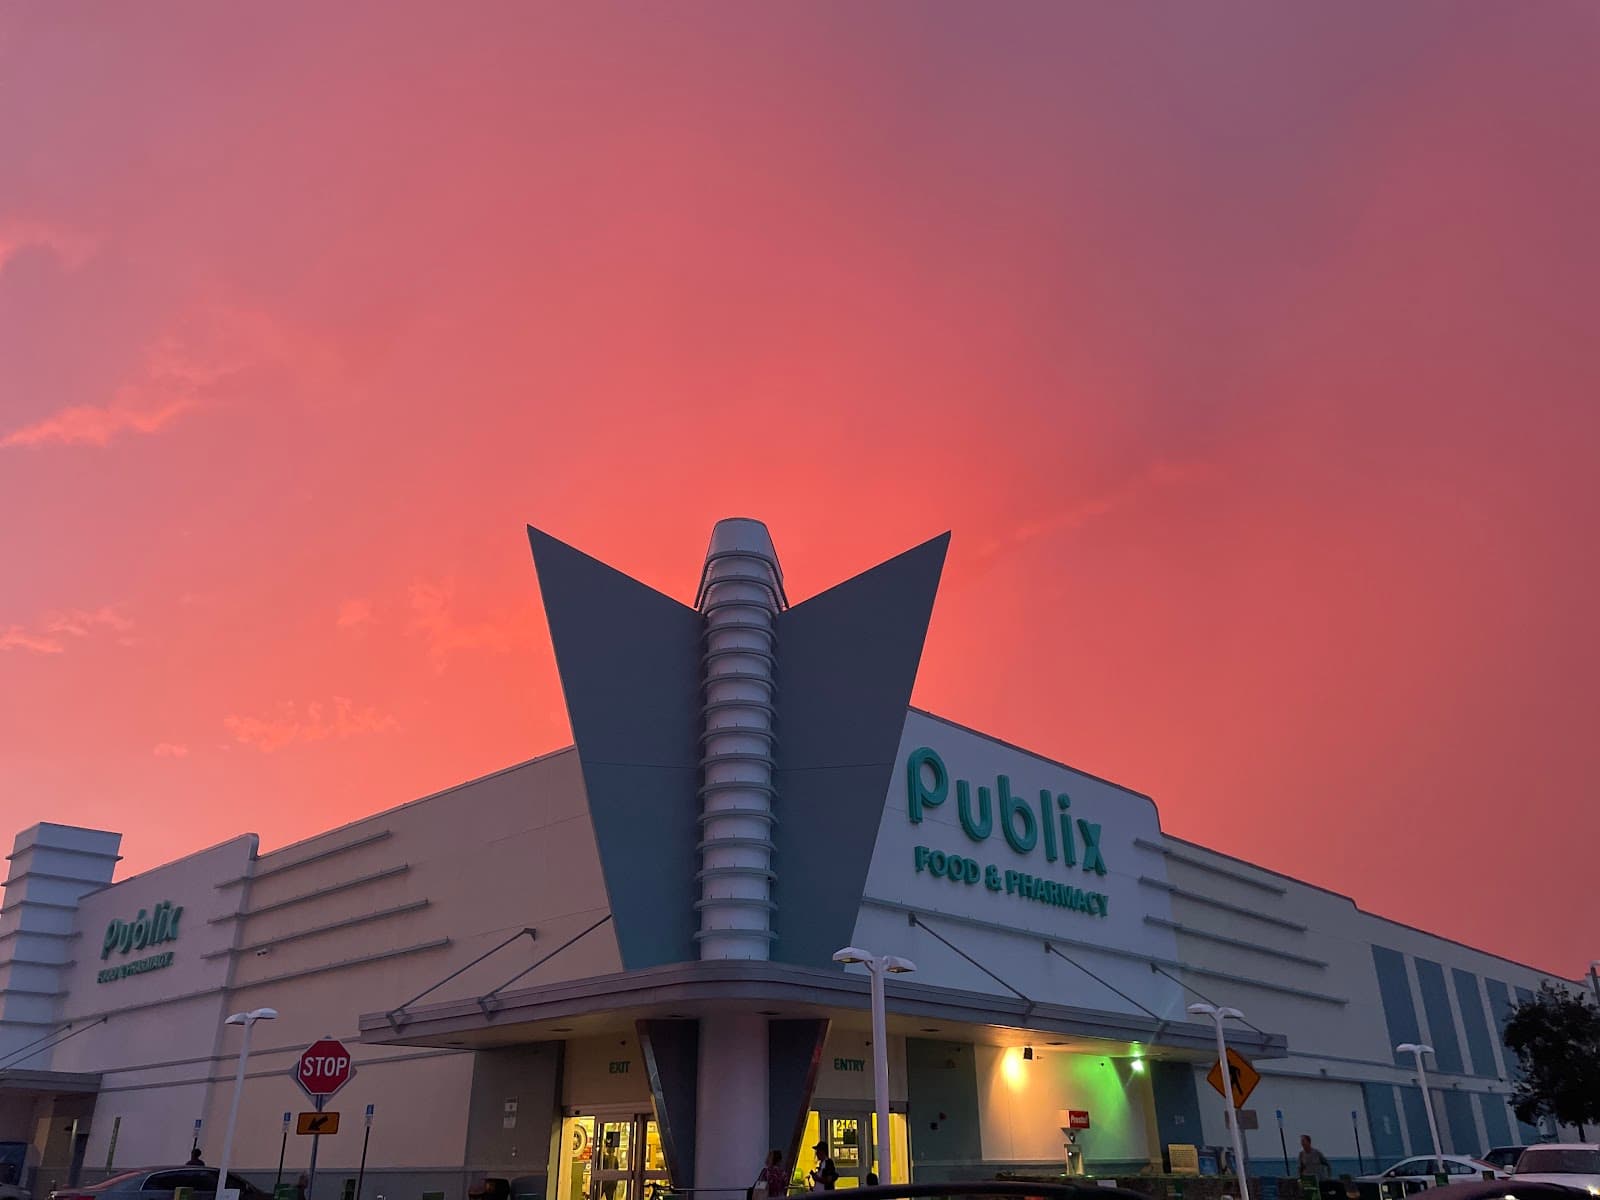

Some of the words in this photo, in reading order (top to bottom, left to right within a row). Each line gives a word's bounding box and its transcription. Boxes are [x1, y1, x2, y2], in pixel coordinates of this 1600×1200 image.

[907, 747, 1107, 875] Publix
[914, 845, 980, 884] FOOD
[985, 864, 1002, 891] &
[1005, 869, 1108, 917] PHARMACY
[101, 900, 183, 960] Publix
[303, 1056, 347, 1077] STOP
[609, 1061, 630, 1074] EXIT
[833, 1058, 865, 1071] ENTRY
